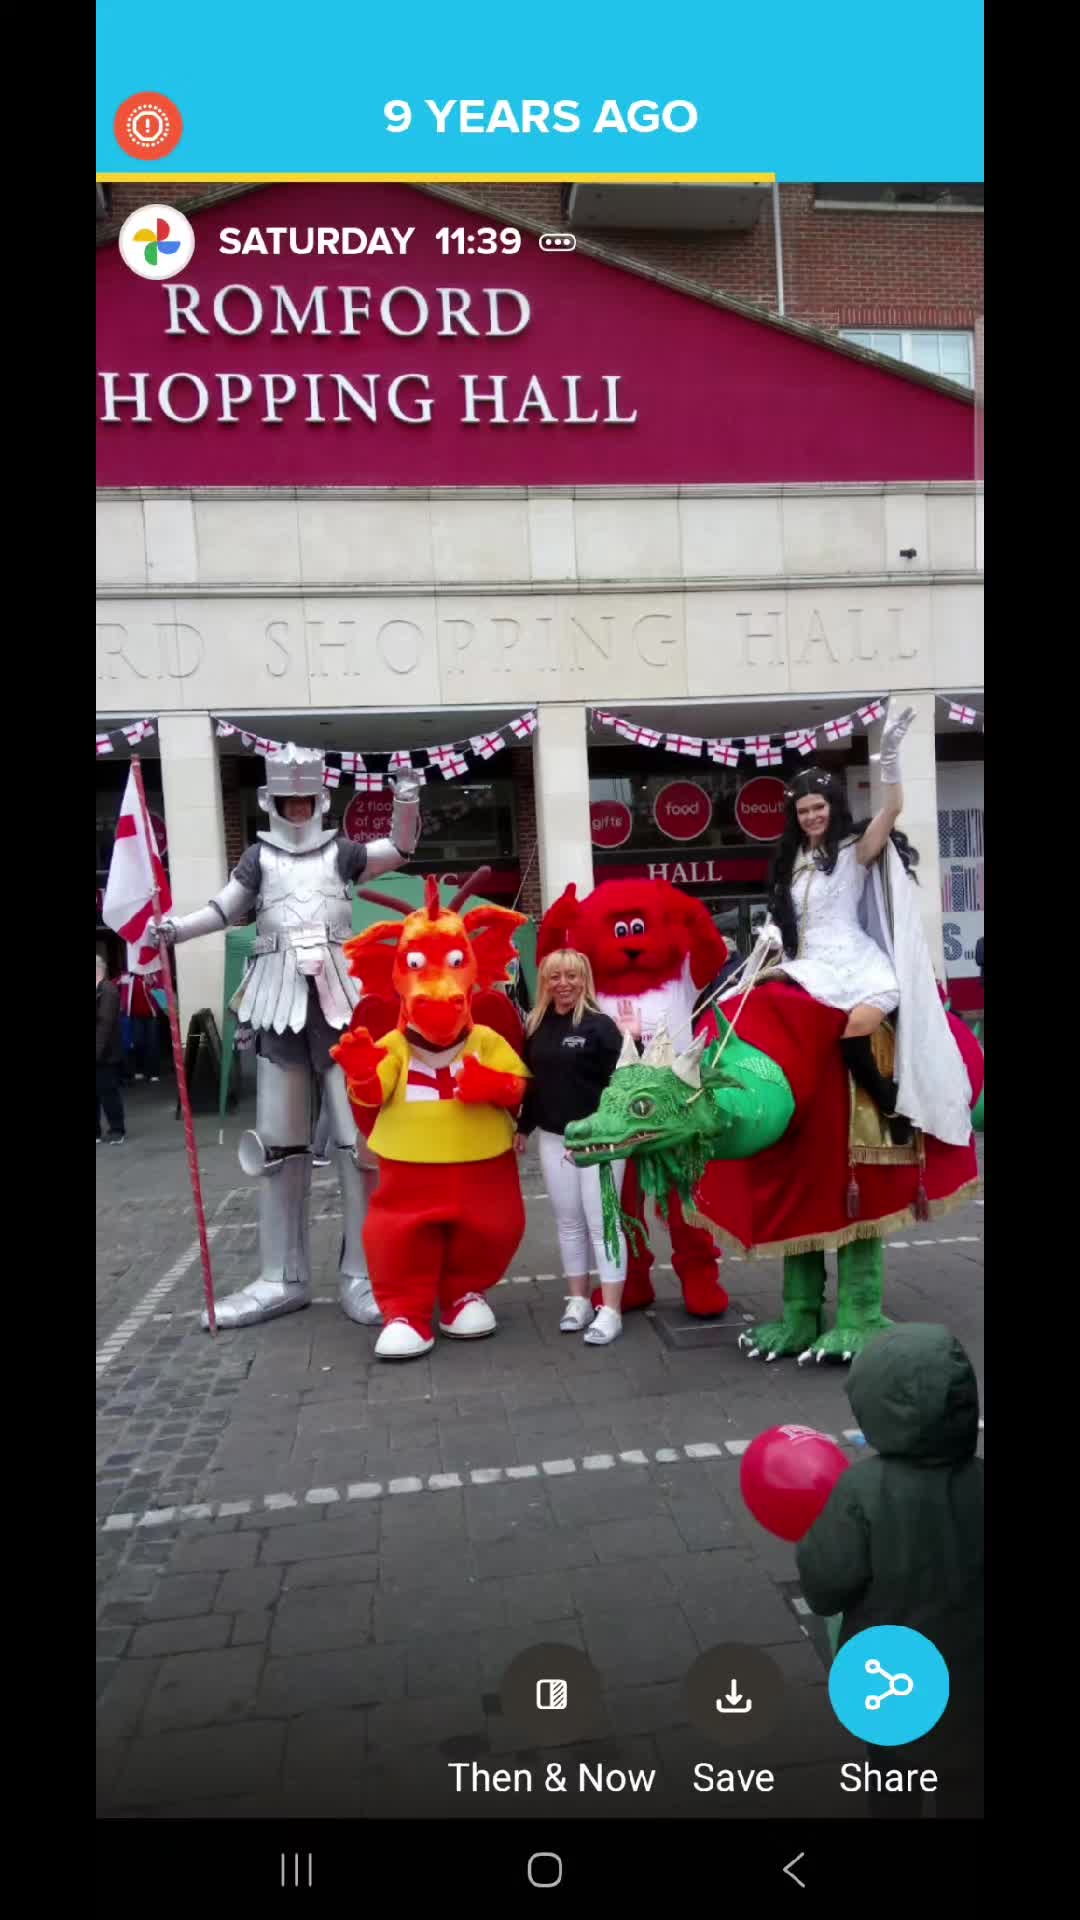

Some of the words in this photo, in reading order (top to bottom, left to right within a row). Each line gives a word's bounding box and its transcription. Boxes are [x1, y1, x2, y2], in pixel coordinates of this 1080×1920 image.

[162, 283, 532, 338] ROMFORD
[97, 371, 434, 424] HOPPING
[460, 374, 638, 424] HALL
[264, 612, 678, 678] SHOPPING
[735, 607, 919, 667] HALL
[368, 799, 392, 812] floo
[664, 801, 700, 816] food
[740, 801, 785, 815] beaut
[591, 816, 624, 832] gifts
[646, 860, 724, 883] HALL
